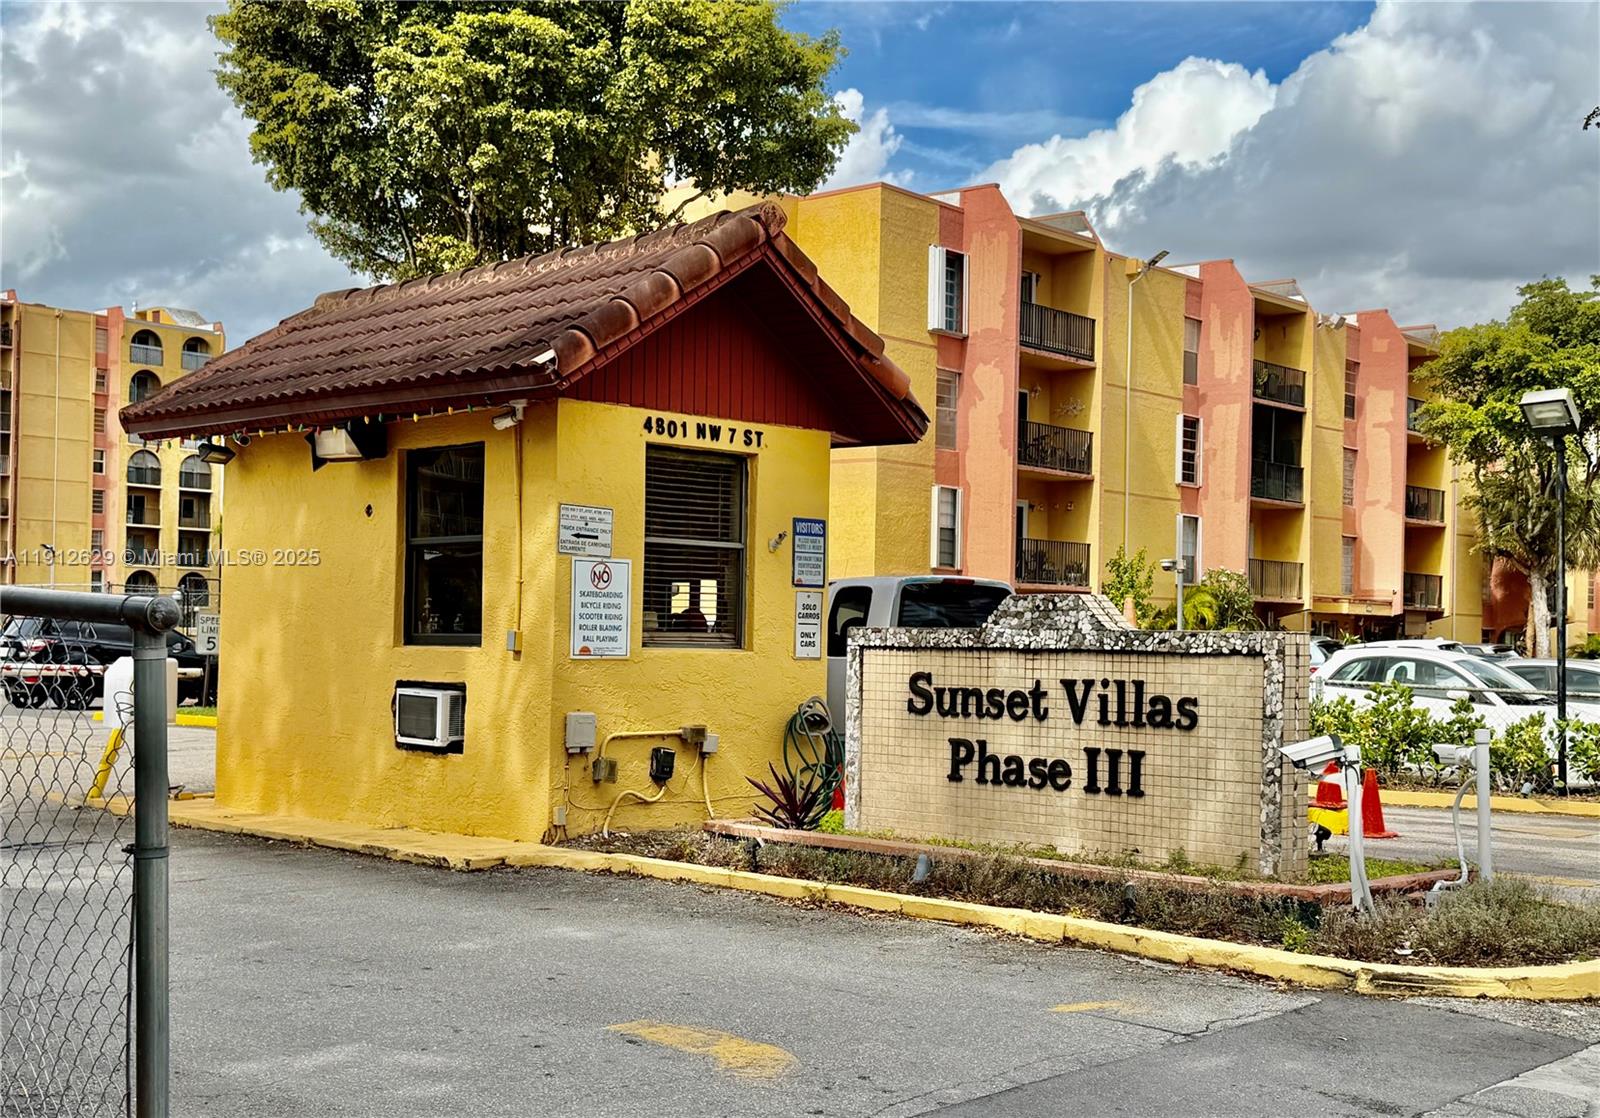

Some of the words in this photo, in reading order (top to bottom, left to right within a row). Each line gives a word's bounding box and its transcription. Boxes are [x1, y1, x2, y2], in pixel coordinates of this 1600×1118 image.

[643, 416, 687, 438] 4801
[696, 422, 721, 442] NW
[728, 427, 737, 444] 7
[743, 429, 764, 448] ST
[795, 521, 824, 535] VISITORS
[560, 538, 580, 546] ENTRADA
[587, 541, 611, 549] CAMIONES
[560, 544, 586, 552] SOLAMENTE
[592, 570, 610, 583] NO
[579, 590, 623, 598] SKATEBOARDING
[603, 602, 621, 610] RIDING
[802, 603, 817, 611] SOLO
[200, 616, 220, 625] SPEE
[579, 612, 603, 620] SCOOTER
[604, 613, 623, 621] RIDING
[797, 612, 820, 620] CARROS
[202, 626, 219, 634] LIMI
[579, 623, 598, 631] ROLLER
[599, 624, 622, 632] BLADING
[596, 635, 618, 643] PLAYING
[800, 631, 816, 639] ONLY
[206, 636, 216, 651] 5
[800, 640, 816, 648] CARS
[907, 671, 1049, 722] Sunset
[1060, 677, 1199, 731] Villas
[947, 737, 1072, 792] Phase
[1083, 747, 1146, 797] III
